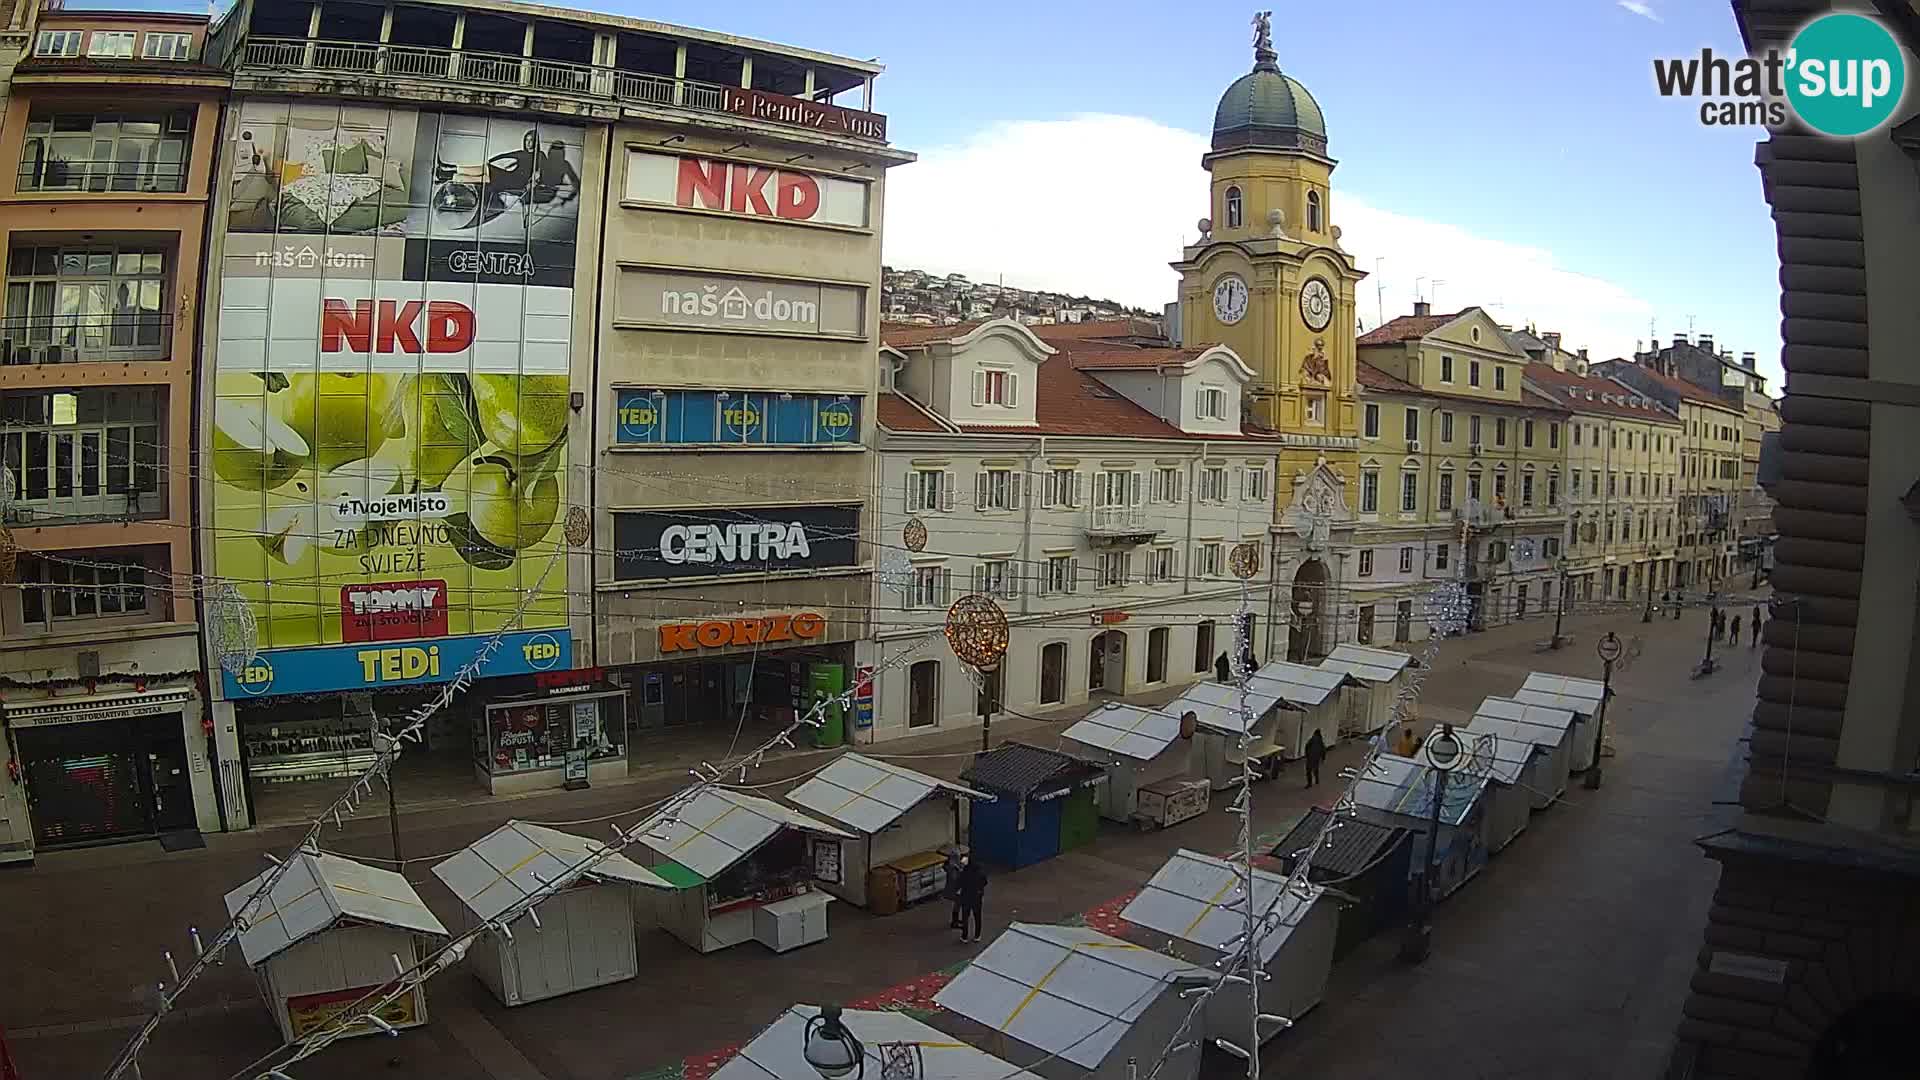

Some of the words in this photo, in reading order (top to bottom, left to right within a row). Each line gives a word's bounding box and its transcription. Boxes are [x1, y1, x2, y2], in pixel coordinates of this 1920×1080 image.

[723, 89, 745, 112] Le
[676, 159, 821, 220] NKD
[255, 246, 295, 268] naš
[319, 247, 366, 269] dom
[448, 250, 535, 276] CENTRA
[662, 285, 718, 317] naš
[754, 290, 816, 324] dom
[321, 298, 477, 354] NKD
[619, 408, 657, 426] TEDi
[724, 409, 760, 426] TEDi
[820, 412, 853, 428] TEDi
[338, 497, 447, 517] #TvojeMisto
[334, 529, 358, 549] ZA
[366, 524, 451, 548] DNEVNO
[659, 521, 811, 564] CENTRA
[359, 547, 426, 575] SVJEŽE
[349, 587, 439, 615] TOMMY
[659, 612, 826, 653] KORZO
[357, 645, 440, 682] TEDi
[522, 642, 560, 661] TEDi
[236, 665, 273, 685] EDi
